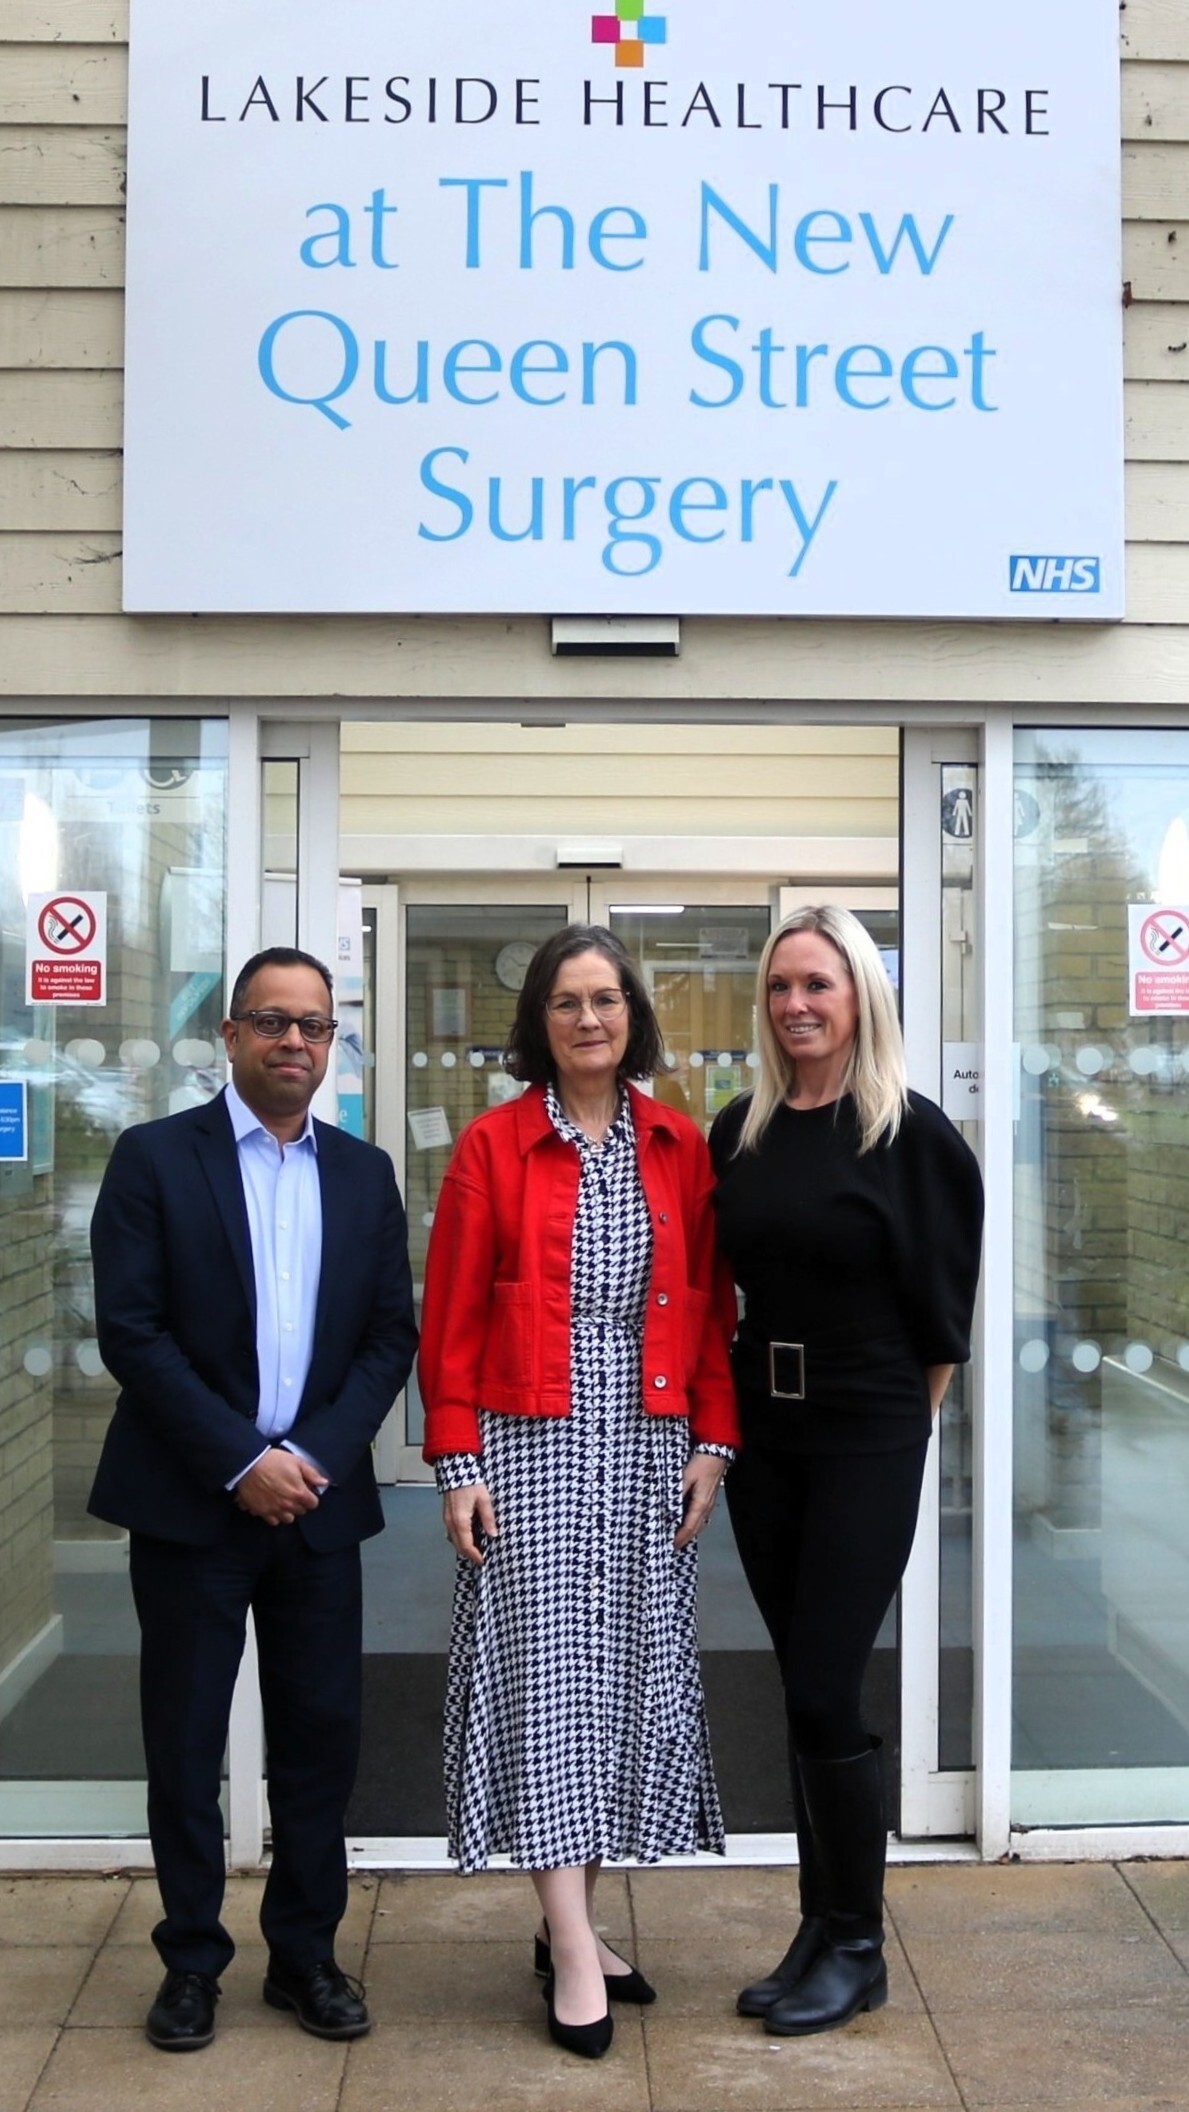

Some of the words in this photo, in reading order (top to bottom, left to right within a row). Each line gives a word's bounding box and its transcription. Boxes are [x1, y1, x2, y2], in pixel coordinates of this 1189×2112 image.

[201, 75, 540, 125] LAKESIDE
[583, 79, 1049, 136] HEALTHCARE
[299, 188, 397, 270] at
[439, 170, 648, 272] The
[699, 181, 954, 276] New
[257, 309, 638, 431] Queen
[689, 313, 996, 412] Street
[418, 446, 838, 577] Surgery
[1011, 557, 1097, 591] NHS
[106, 801, 161, 814] Tets
[35, 963, 51, 973] No
[52, 963, 98, 976] smoking
[1137, 974, 1153, 985] No
